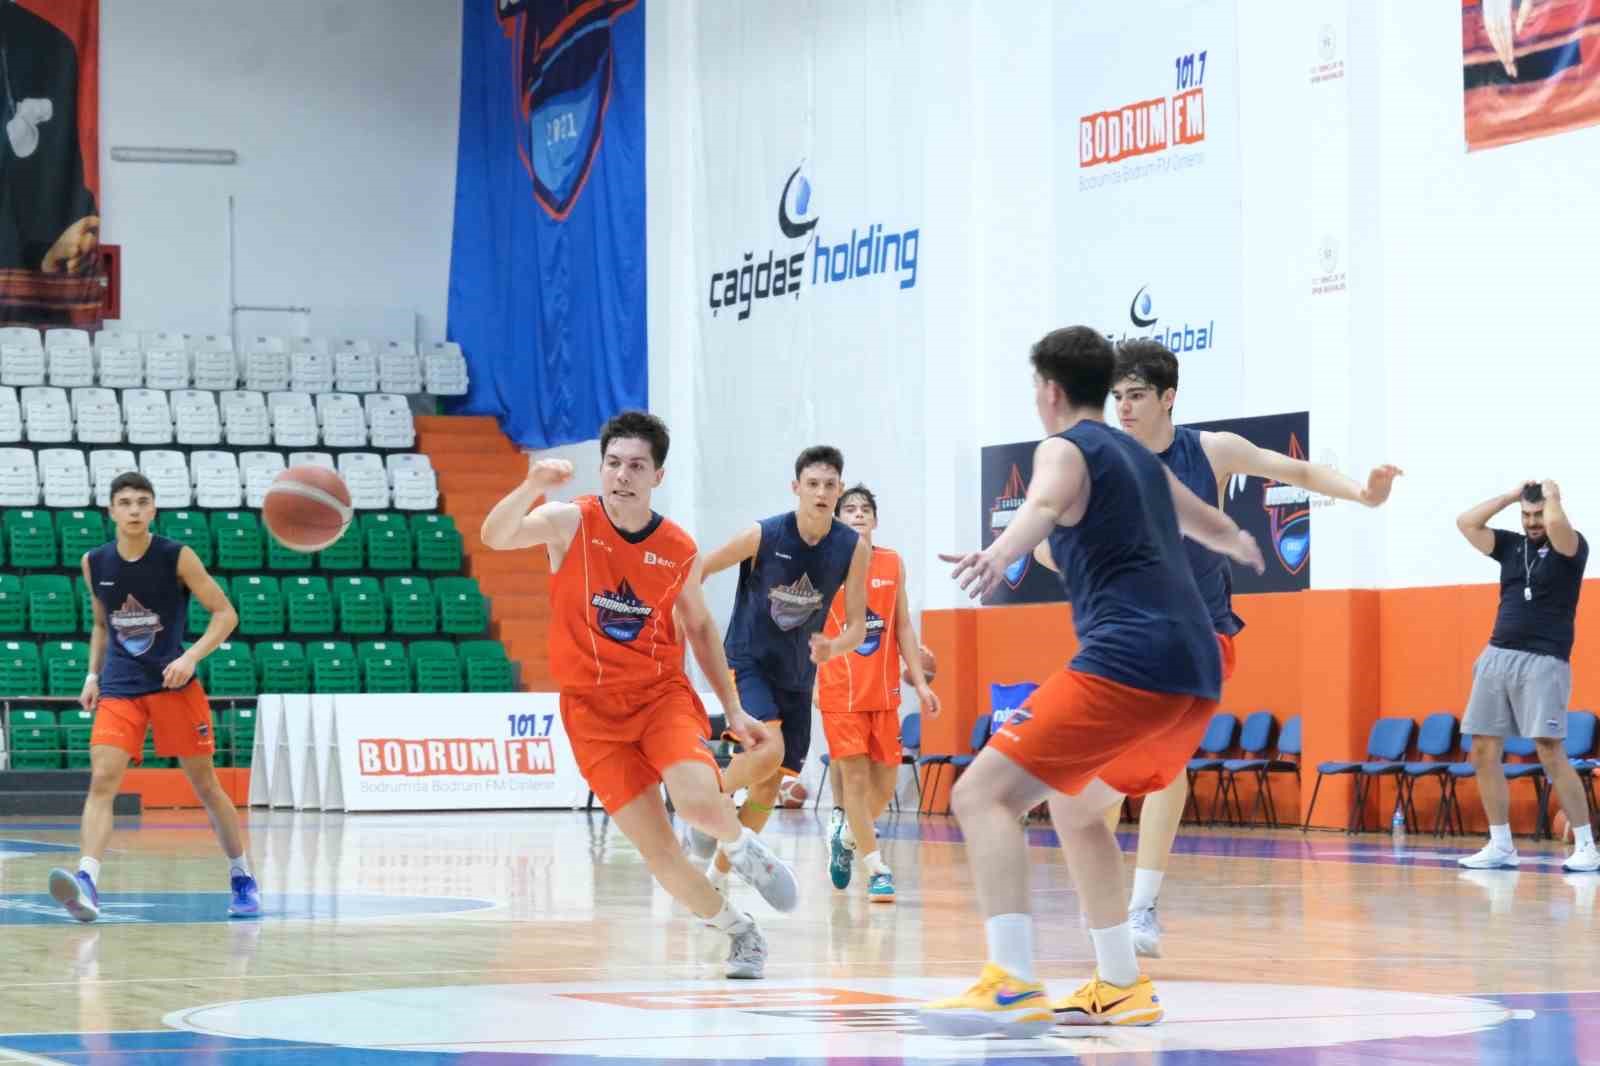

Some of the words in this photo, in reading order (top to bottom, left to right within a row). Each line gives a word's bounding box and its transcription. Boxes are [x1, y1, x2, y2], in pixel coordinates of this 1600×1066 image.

[1175, 50, 1207, 91] 101.7
[1080, 100, 1166, 165] BODRUM
[1173, 92, 1204, 144] FM
[709, 250, 805, 321] çağdaş
[812, 223, 919, 289] holding
[508, 714, 554, 737] 101.7
[360, 740, 498, 774] BODRUM
[507, 740, 553, 773] FM
